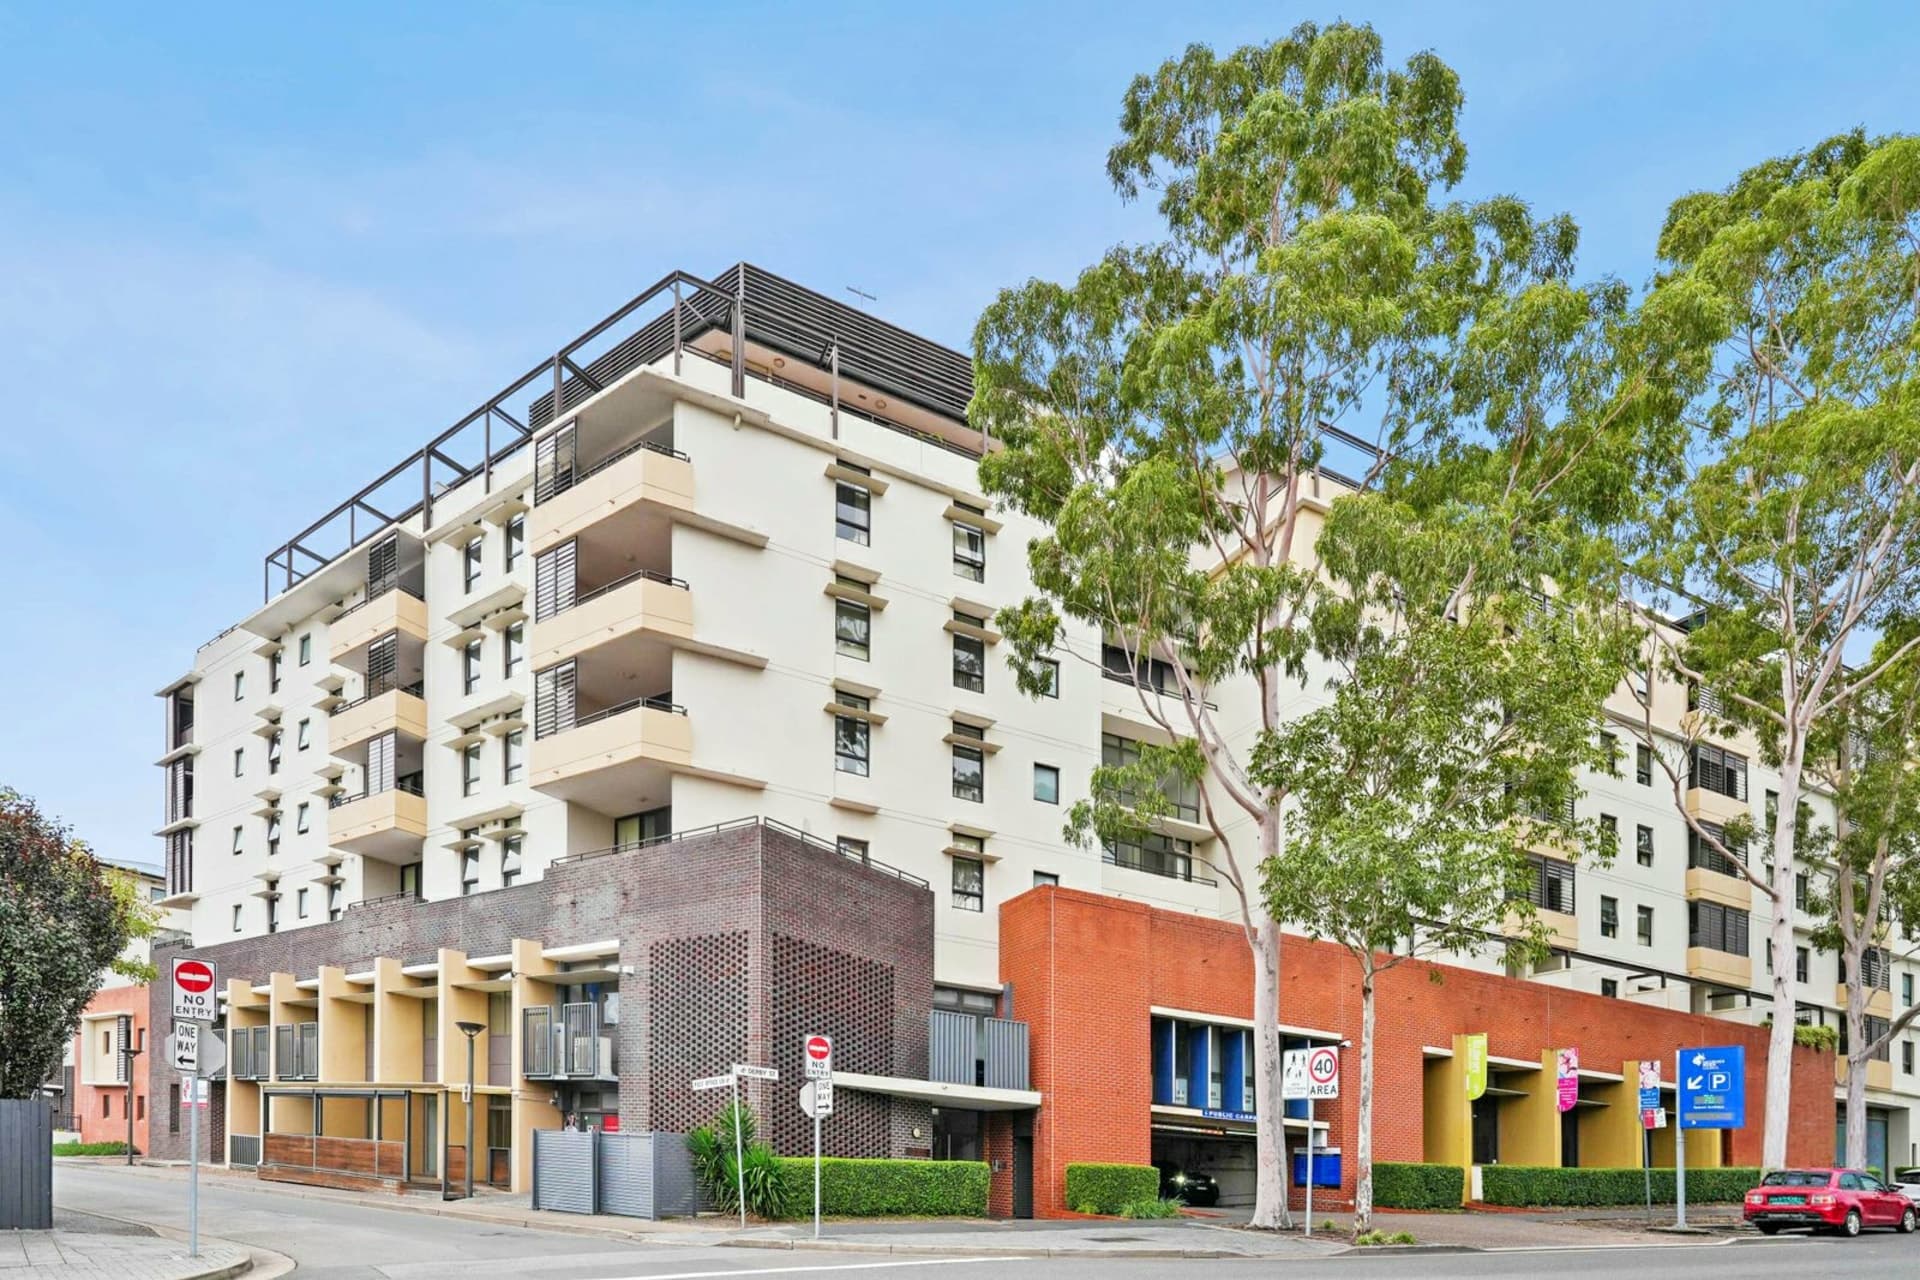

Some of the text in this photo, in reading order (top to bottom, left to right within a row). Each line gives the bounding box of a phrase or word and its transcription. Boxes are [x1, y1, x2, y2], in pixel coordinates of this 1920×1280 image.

[184, 994, 205, 1006] NO
[175, 1005, 212, 1017] ENTRY
[178, 1025, 196, 1039] ONE
[177, 1040, 197, 1054] WAY
[811, 1061, 825, 1069] NO
[1314, 1058, 1333, 1074] 40
[807, 1069, 829, 1077] ENTRY
[818, 1082, 830, 1091] ONE
[1712, 1074, 1726, 1089] P
[1310, 1084, 1337, 1095] AREA
[818, 1093, 831, 1101] WAY
[1208, 1110, 1233, 1119] PUBLIC
